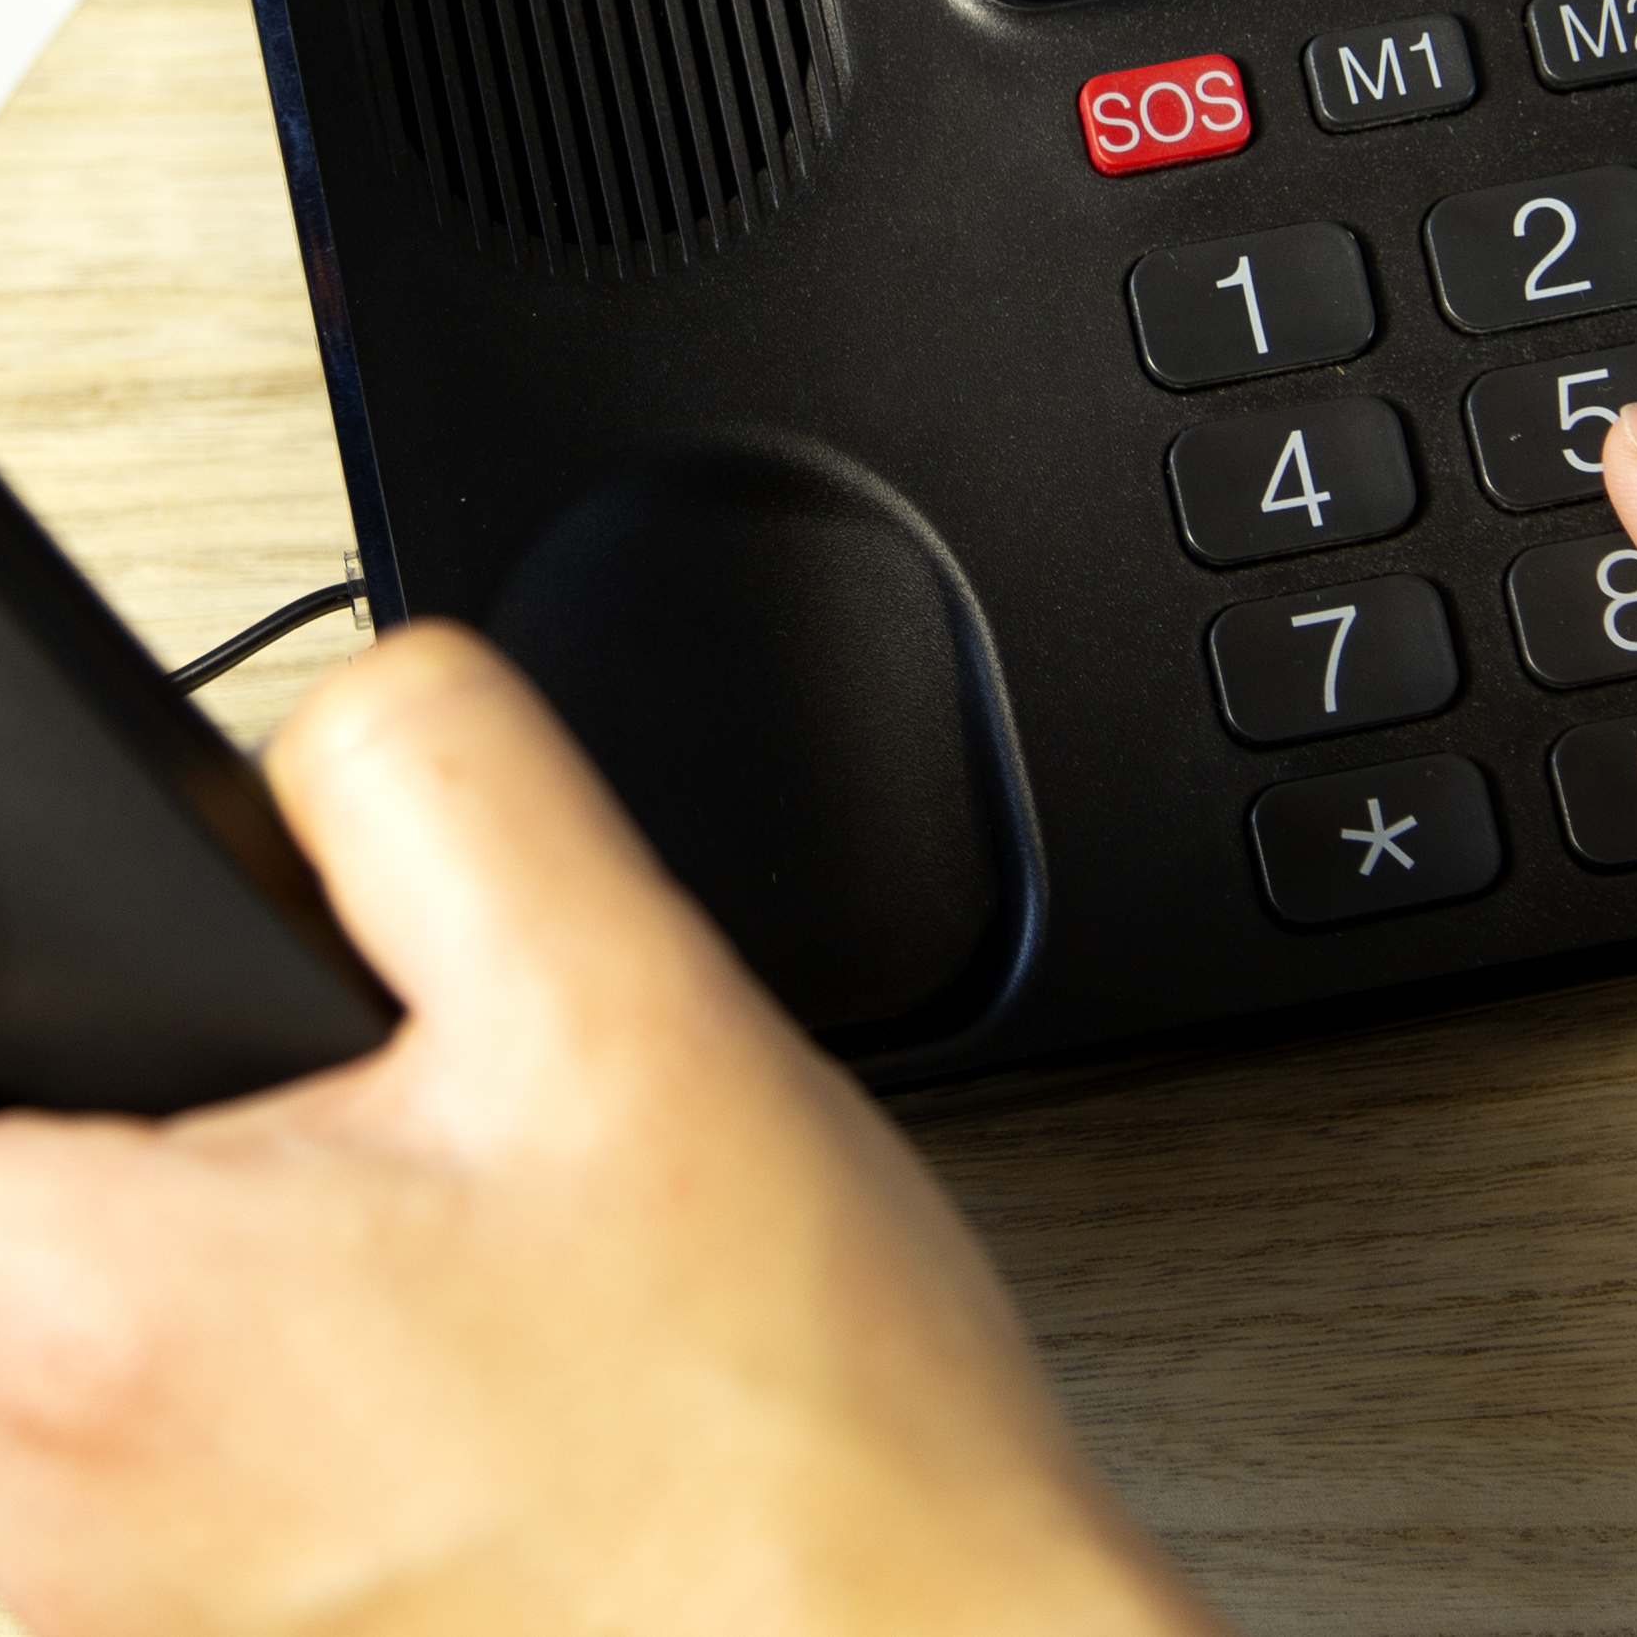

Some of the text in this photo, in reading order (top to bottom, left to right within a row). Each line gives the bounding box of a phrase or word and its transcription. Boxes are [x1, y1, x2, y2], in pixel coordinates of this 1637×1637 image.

[1092, 69, 1244, 154] SOS
[1338, 31, 1442, 105] M1
[1512, 197, 1592, 302] 2
[1215, 255, 1269, 354] 1
[1558, 368, 1620, 473] 5
[1260, 429, 1331, 528] 4
[1290, 604, 1357, 713] 7
